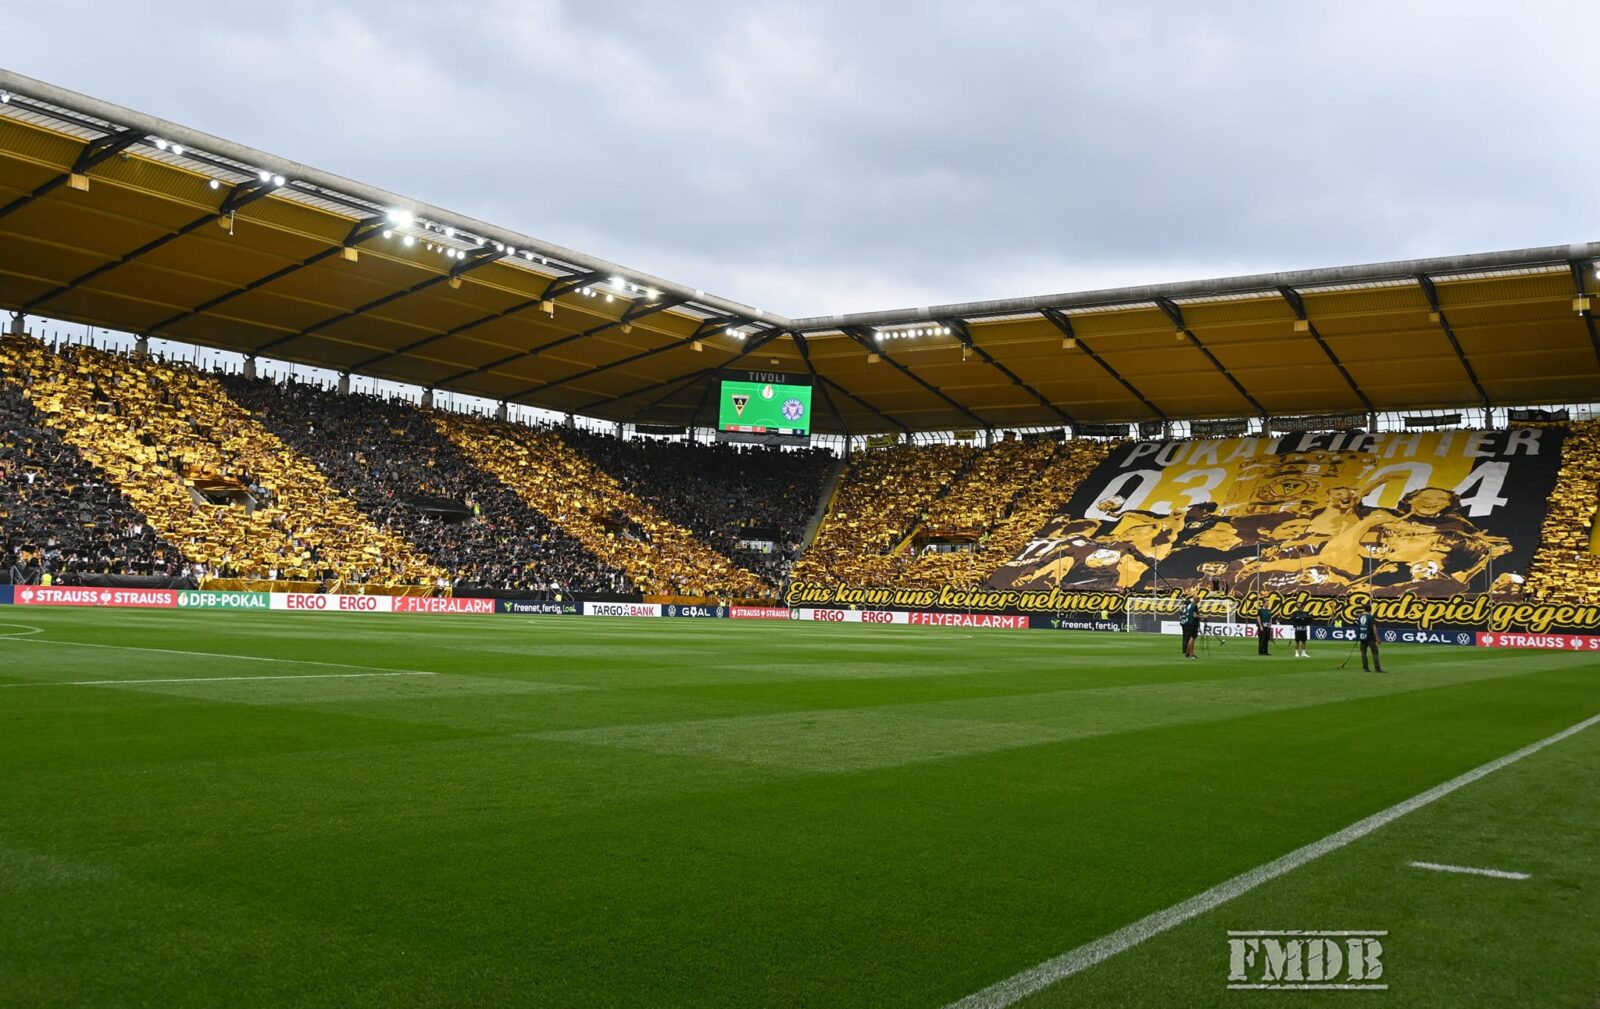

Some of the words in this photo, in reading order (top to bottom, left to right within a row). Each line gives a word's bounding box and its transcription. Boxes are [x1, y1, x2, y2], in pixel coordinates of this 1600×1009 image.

[748, 372, 785, 383] TIVOLI
[1084, 468, 1228, 522] 03
[36, 590, 98, 602] STRAUSS
[114, 592, 171, 604] STRAUSS
[190, 593, 266, 607] DFB-POKAL
[287, 595, 326, 609] ERGO
[339, 596, 377, 610] ERGO
[408, 598, 492, 614] FLYERALARM
[514, 603, 542, 614] freenet,
[736, 609, 761, 617] STRAUSS
[785, 581, 834, 606] Eins
[835, 583, 892, 605] kann
[895, 588, 937, 607] uns
[938, 583, 1017, 609] keiner
[1019, 586, 1122, 612] nehmen
[1123, 588, 1183, 613] und
[1282, 592, 1341, 617] das
[1344, 592, 1490, 629] Endspiel
[1492, 603, 1600, 632] gegen
[813, 610, 845, 622] ERGO
[861, 611, 893, 624] ERGO
[922, 613, 1014, 629] FLYERALARM
[1061, 620, 1095, 631] freenet,
[1095, 621, 1120, 632] fertig,
[1402, 631, 1452, 644] GOAL
[1500, 635, 1564, 648] STRAUSS
